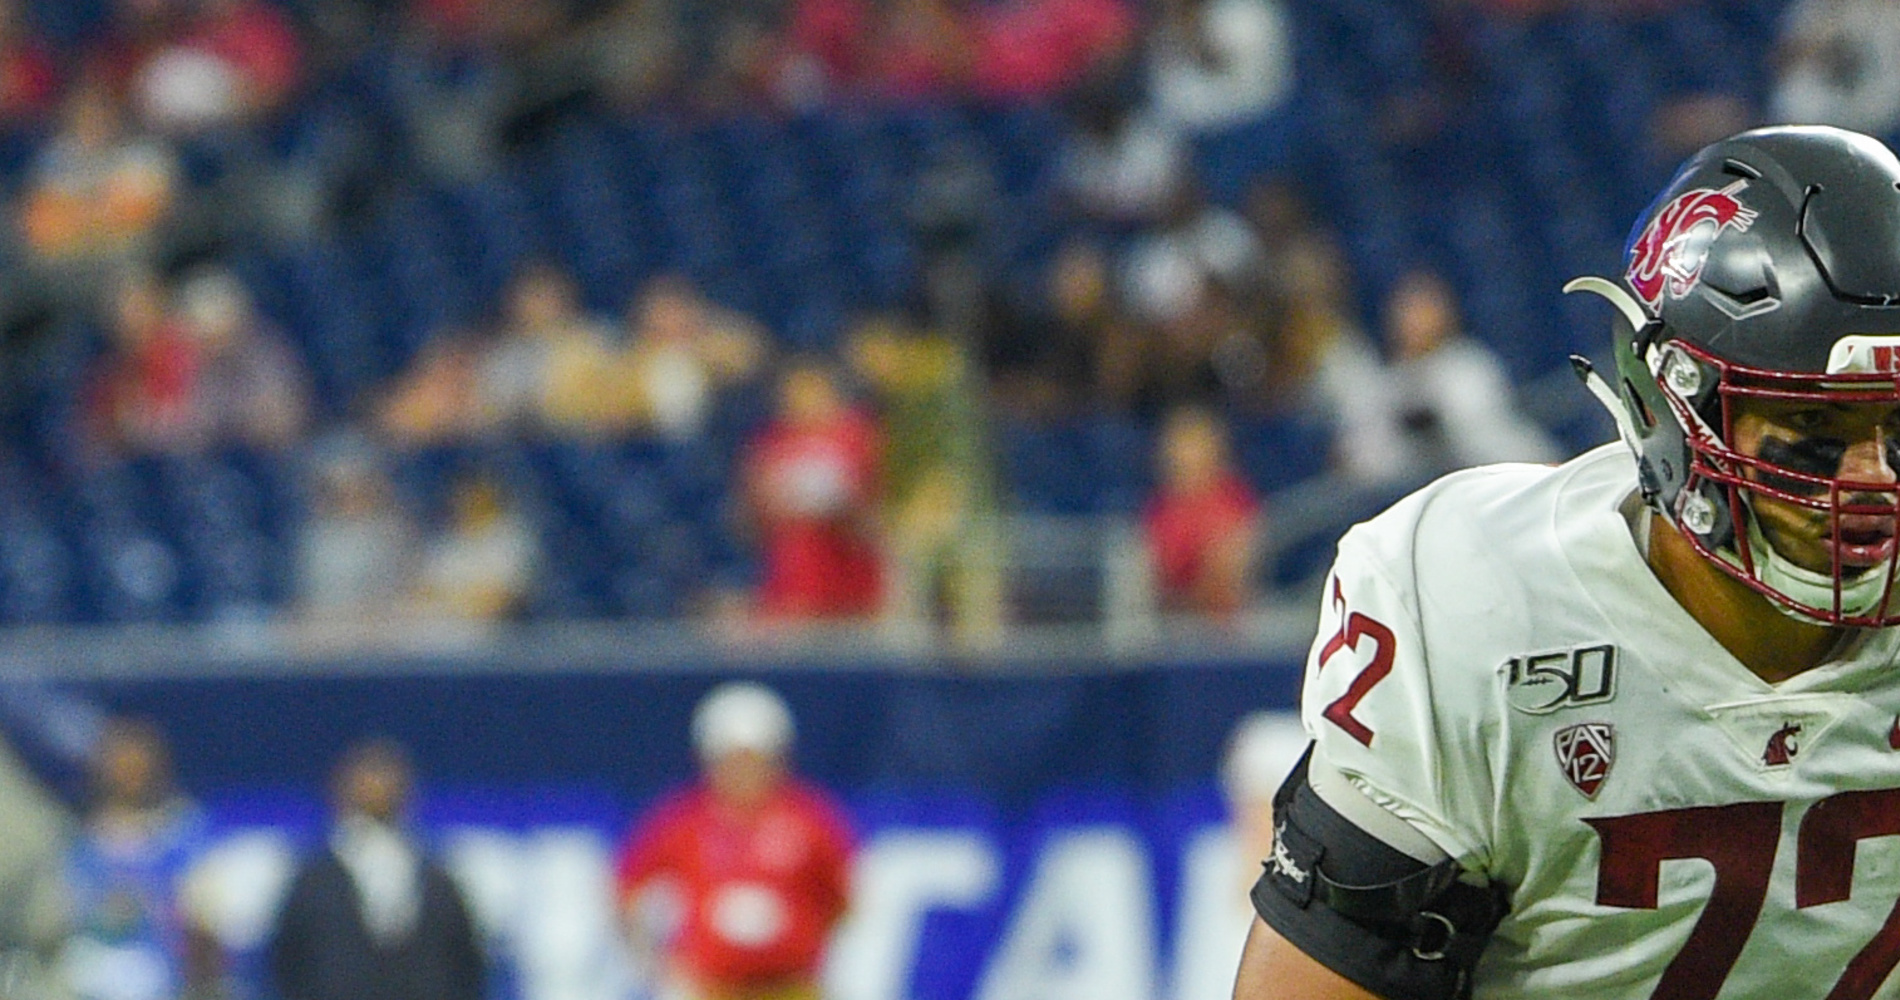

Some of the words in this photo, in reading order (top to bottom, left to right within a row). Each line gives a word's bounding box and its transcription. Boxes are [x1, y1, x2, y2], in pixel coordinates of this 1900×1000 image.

[1503, 644, 1614, 711] 150
[1556, 723, 1612, 771] PAC
[1573, 753, 1603, 783] 12
